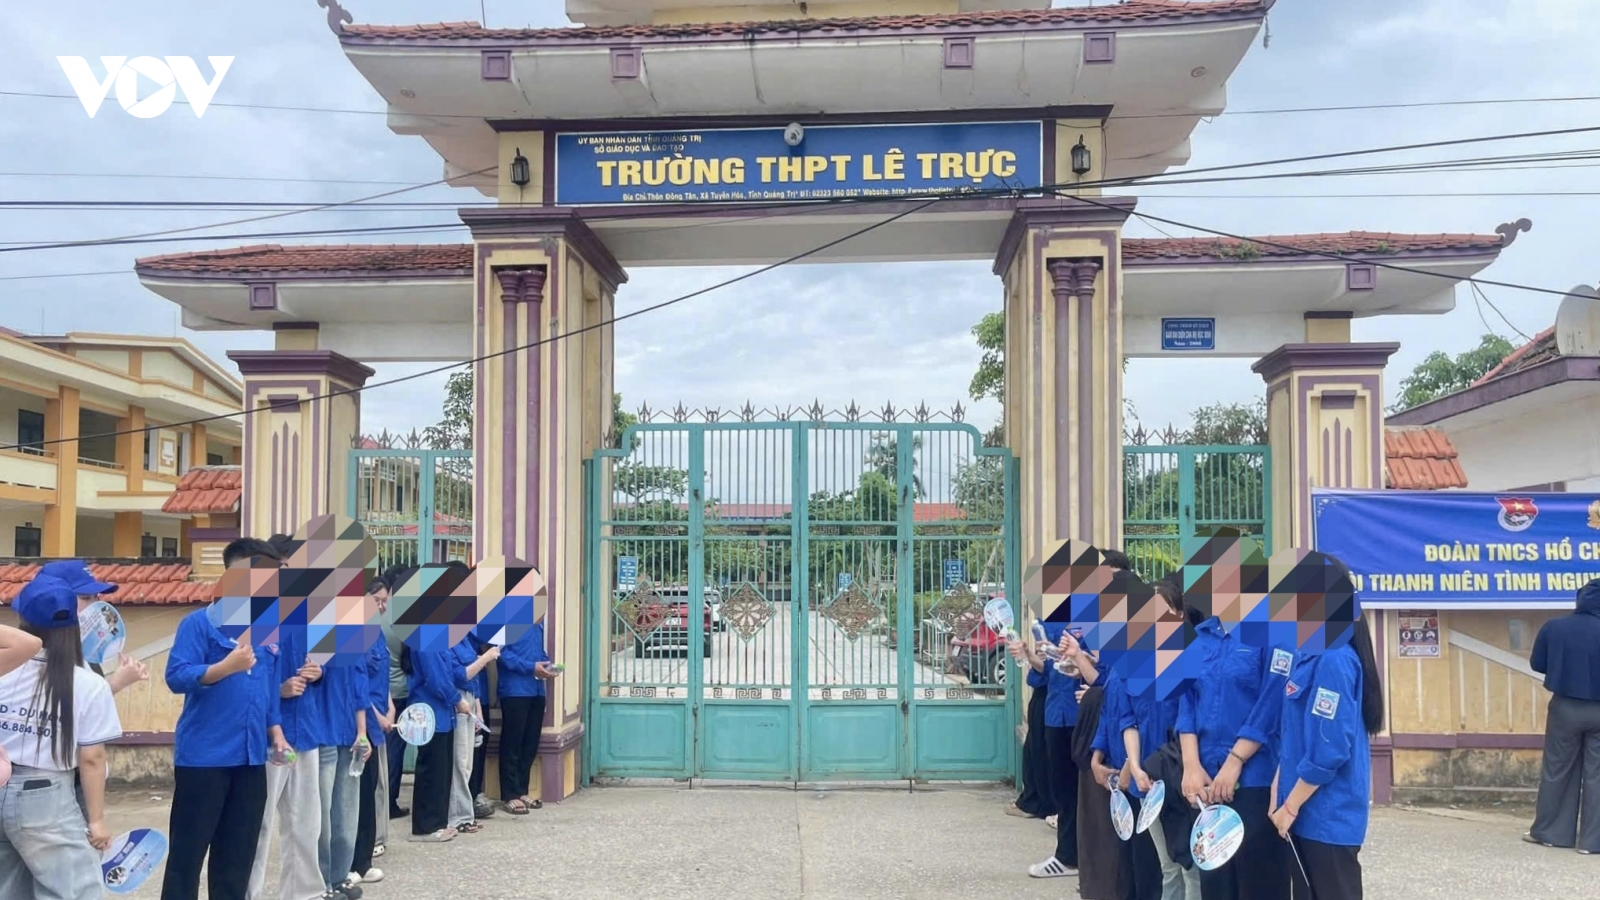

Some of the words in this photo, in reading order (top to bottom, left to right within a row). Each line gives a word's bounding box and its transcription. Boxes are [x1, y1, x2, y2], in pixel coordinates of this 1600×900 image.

[589, 136, 604, 144] BAN
[689, 134, 702, 144] TRỊ
[605, 144, 624, 153] GIÁO
[624, 144, 640, 154] DỤC
[641, 143, 651, 152] VÀ
[596, 153, 745, 187] TRƯỜNG
[756, 155, 852, 183] THPT
[862, 147, 906, 181] LÊ
[916, 148, 1016, 183] TRỰC
[1424, 540, 1480, 562] ĐOÀN
[1485, 542, 1539, 562] TNCS
[1544, 536, 1572, 561] HỒ
[1369, 573, 1434, 592] THANH
[1440, 569, 1489, 592] NIÊN
[1494, 569, 1542, 591] TÌNH
